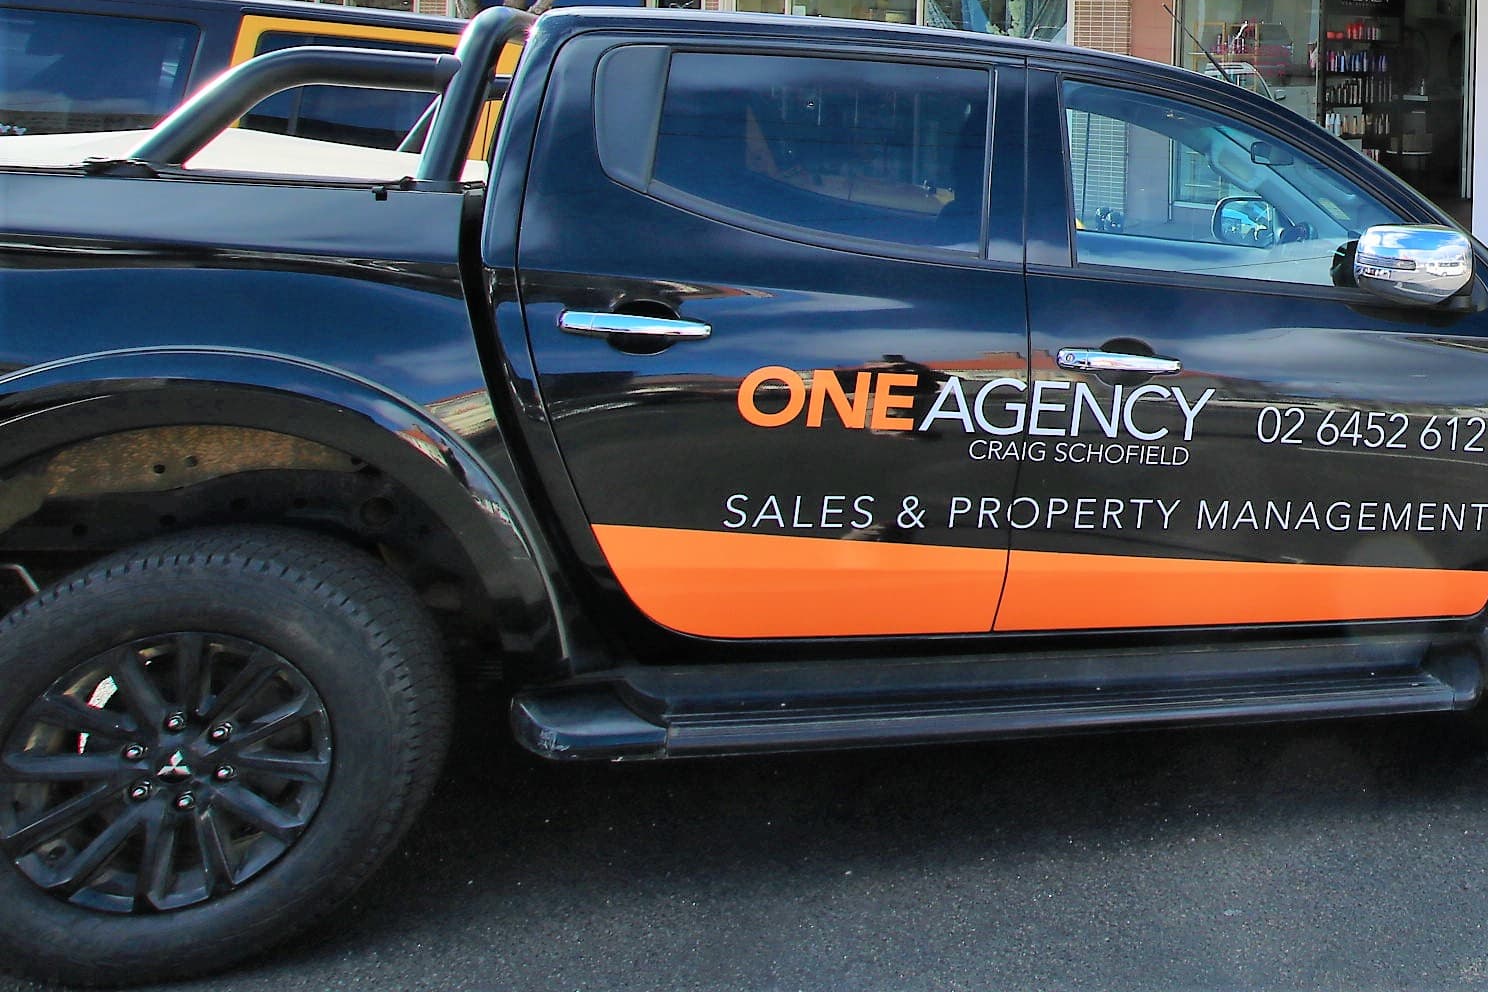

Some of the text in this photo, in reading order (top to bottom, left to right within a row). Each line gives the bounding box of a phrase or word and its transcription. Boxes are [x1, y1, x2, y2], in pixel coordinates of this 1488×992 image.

[1256, 406, 1307, 445] 02
[1316, 410, 1408, 449] 6452
[968, 439, 1190, 466] CRAIG SCHOFIELD
[722, 494, 876, 530] SALES
[896, 495, 926, 530] &
[948, 497, 1181, 530] PROPERTY
